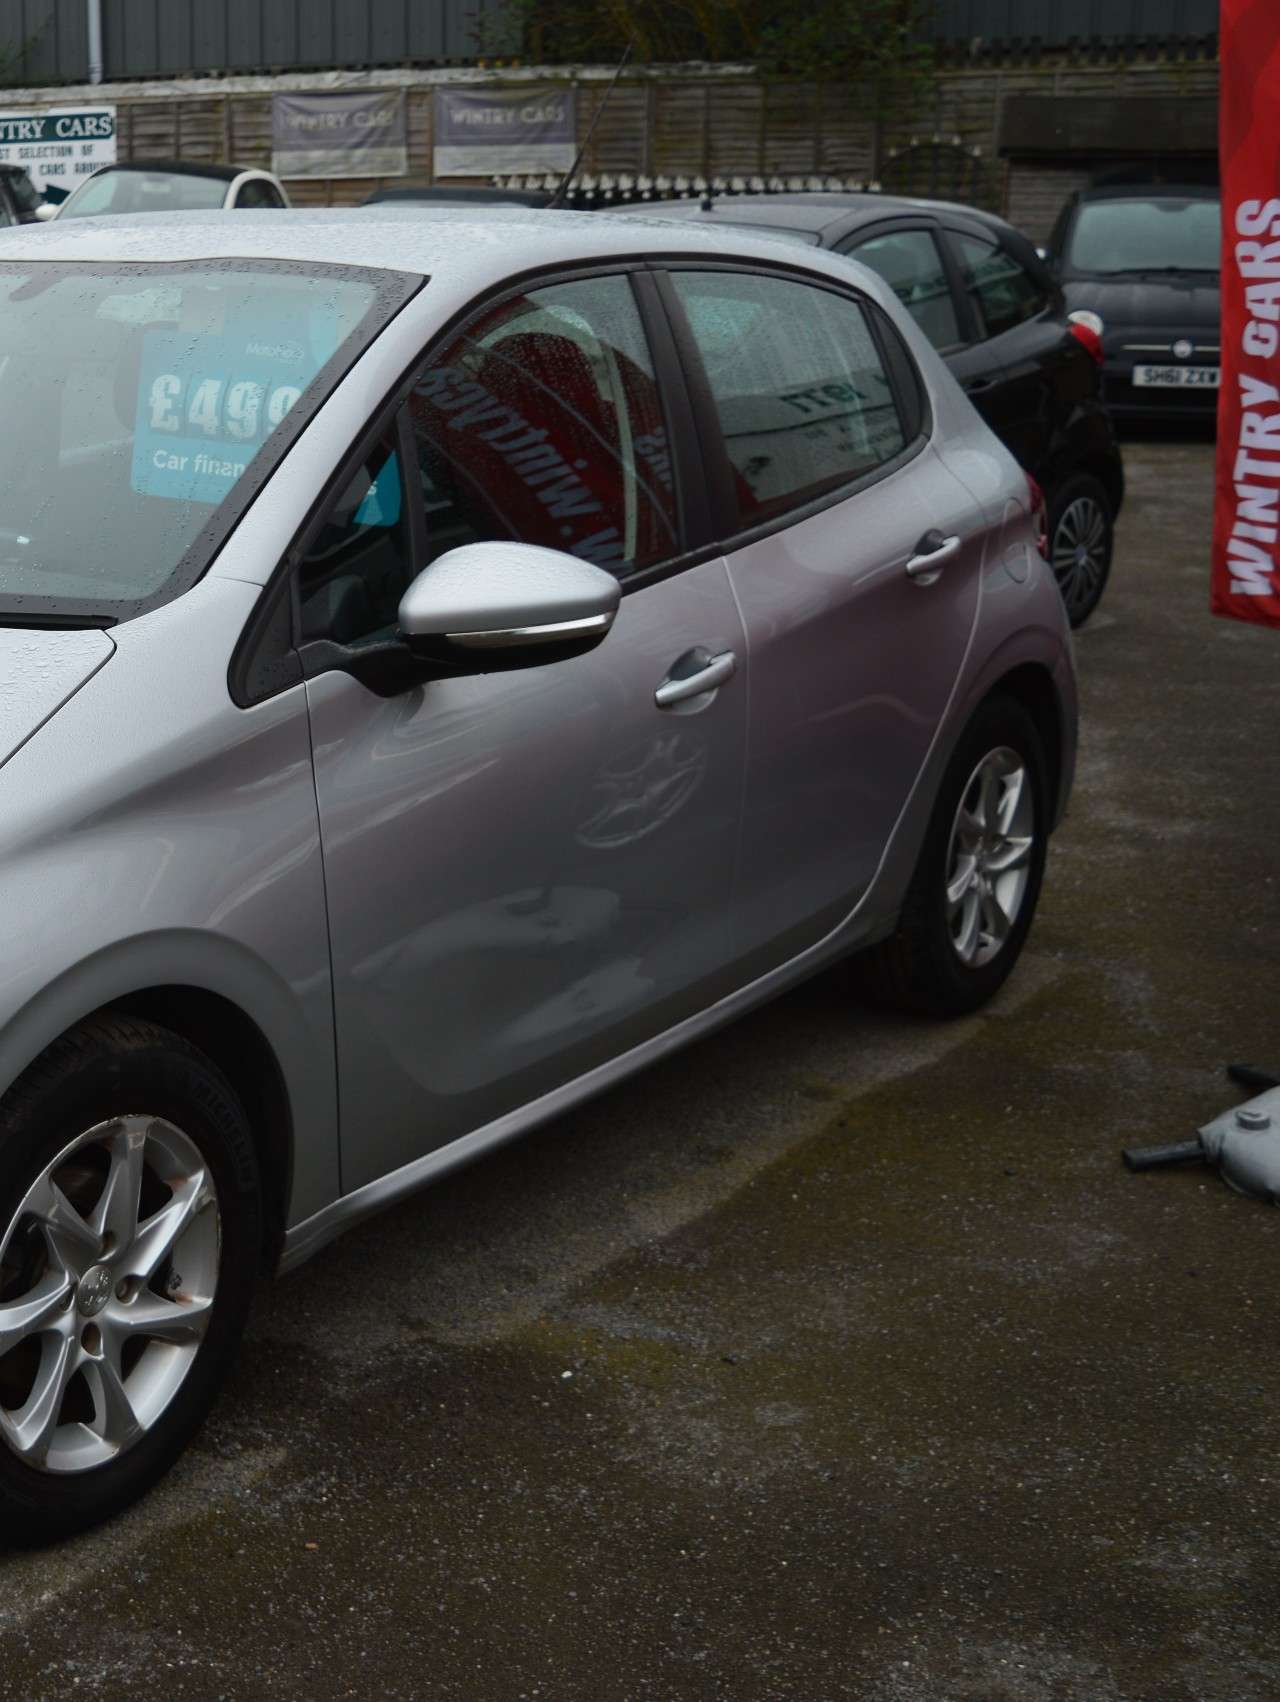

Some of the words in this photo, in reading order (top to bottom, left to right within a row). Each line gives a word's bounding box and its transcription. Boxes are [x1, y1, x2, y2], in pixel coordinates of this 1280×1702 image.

[449, 107, 516, 125] WINTRY
[520, 105, 565, 123] CARS
[56, 115, 113, 138] CARS
[18, 145, 73, 159] SELECTION
[1235, 198, 1280, 360] CARS
[153, 450, 189, 472] Car
[1226, 373, 1280, 597] WINTRY
